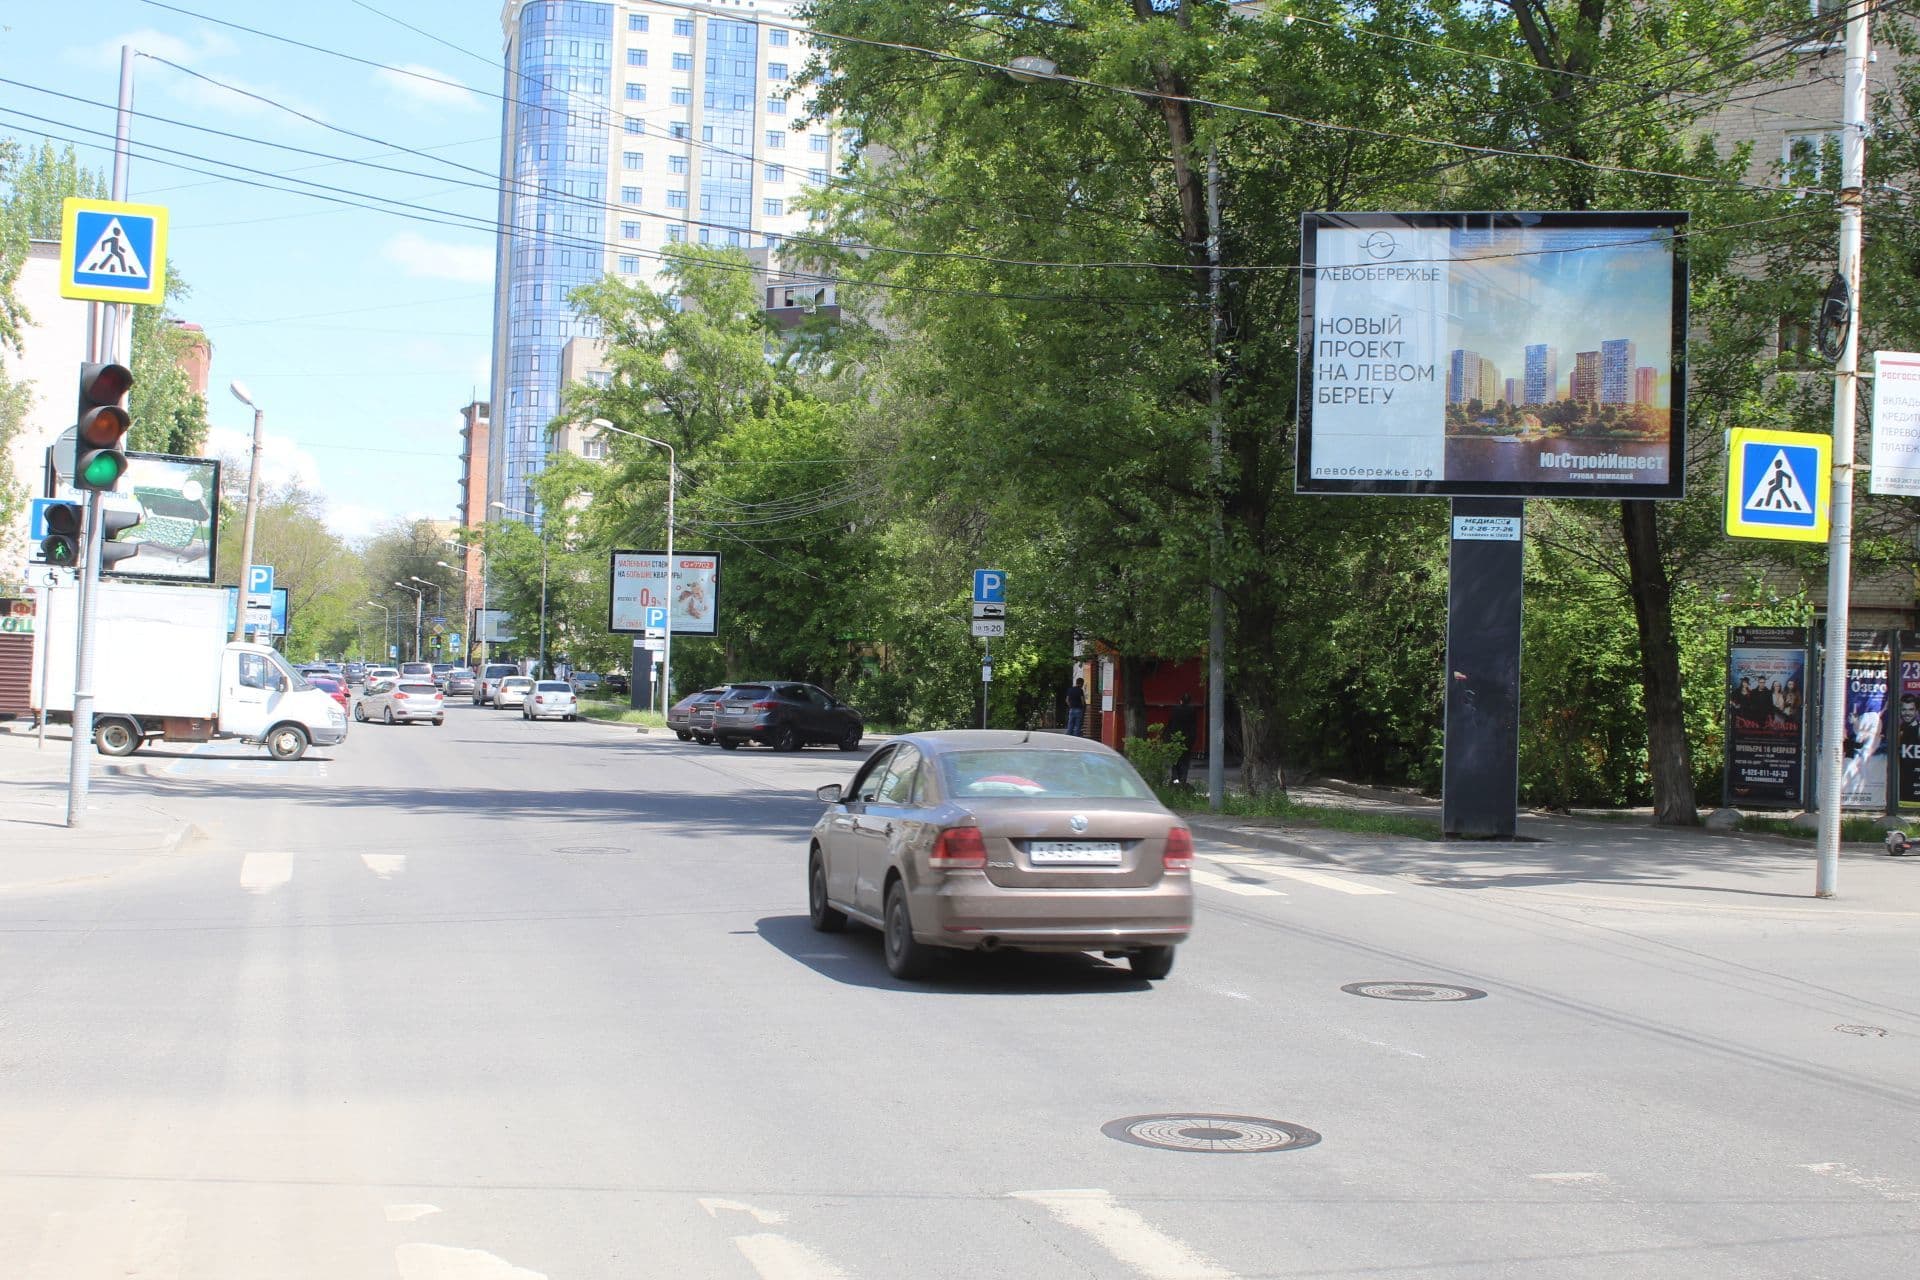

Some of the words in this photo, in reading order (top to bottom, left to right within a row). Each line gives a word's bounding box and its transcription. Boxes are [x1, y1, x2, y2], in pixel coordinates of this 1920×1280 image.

[1319, 266, 1441, 282] ЛЕВОБЕРЕЖЬЕ
[1319, 314, 1402, 335] НОВЫЙ
[1319, 340, 1406, 358] ПРОЕКТ
[1318, 363, 1351, 381] НА
[1354, 364, 1435, 382] ЛЕВОМ
[1318, 386, 1395, 405] БЕРЕГУ
[1881, 411, 1920, 426] КРЕДИТ
[1540, 452, 1665, 470] ЮгСтройИнвест
[1314, 465, 1434, 480] левобережье.рф
[250, 568, 268, 592] P
[982, 573, 1001, 599] P
[651, 609, 664, 626] P
